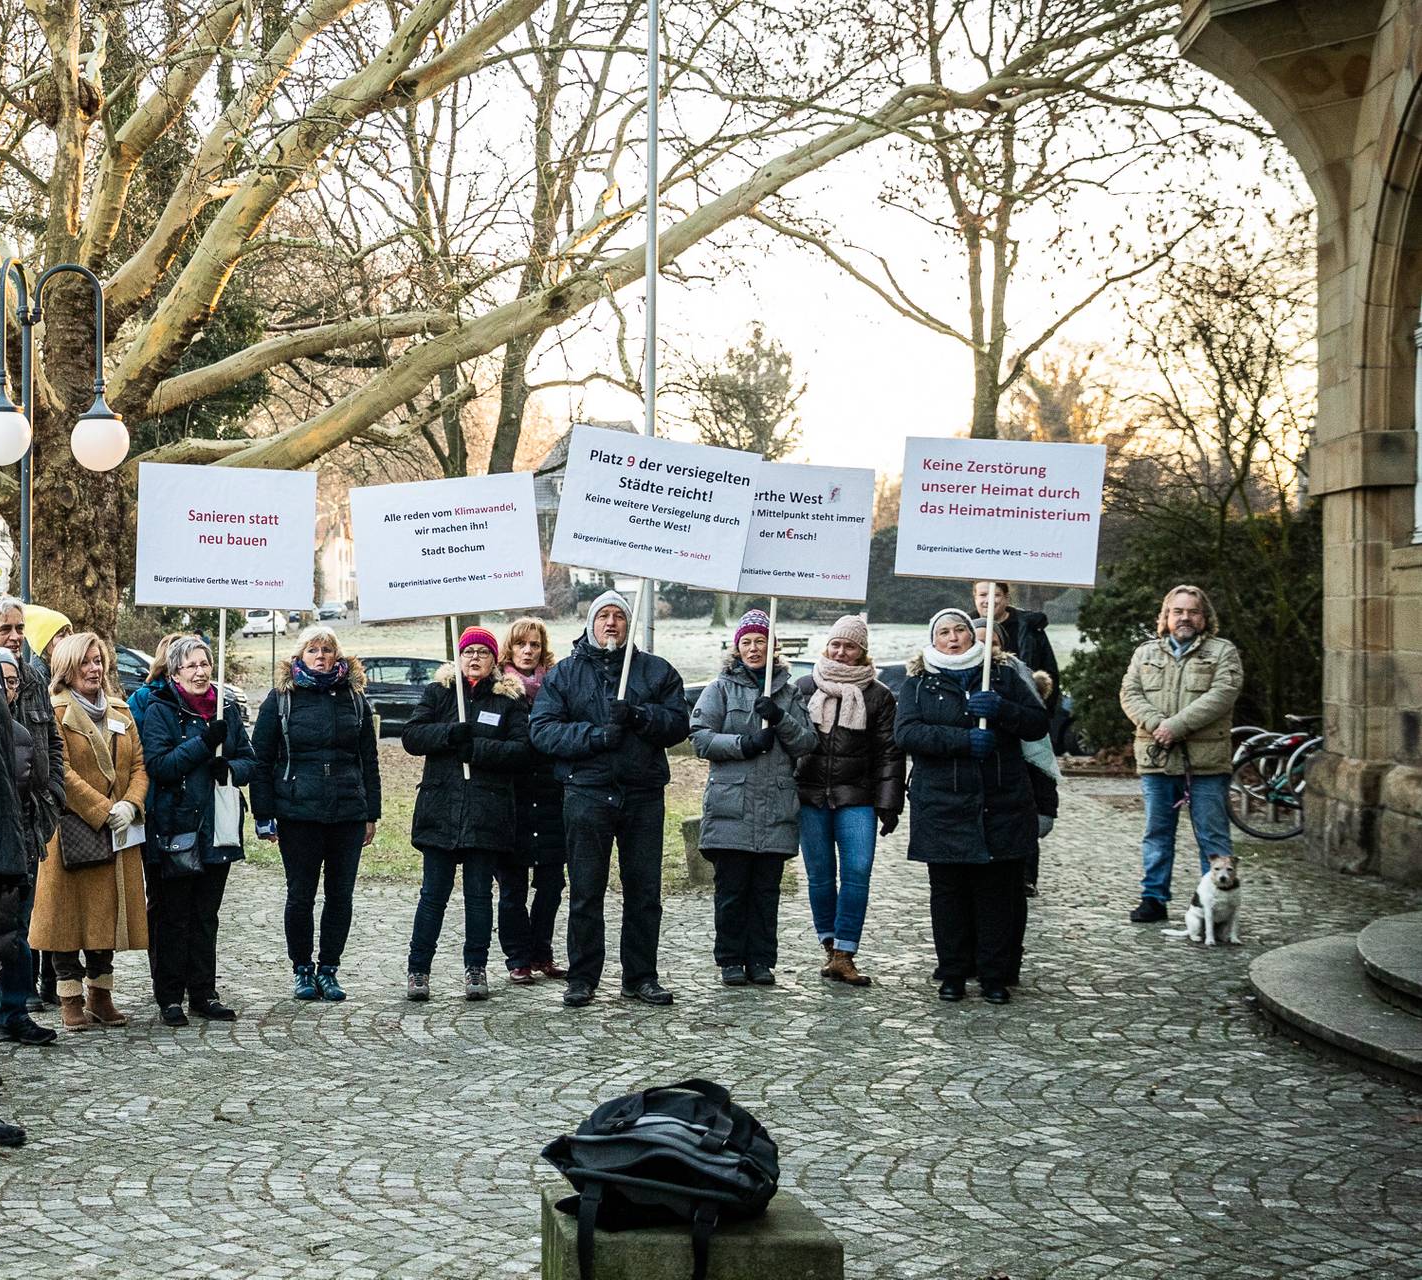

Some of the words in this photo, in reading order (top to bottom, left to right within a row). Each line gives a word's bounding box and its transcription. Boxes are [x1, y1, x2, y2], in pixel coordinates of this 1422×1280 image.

[590, 450, 623, 465] Platz
[627, 456, 635, 467] 9
[639, 458, 662, 471] der
[666, 465, 750, 486] versiegelten
[923, 459, 962, 471] Keine
[967, 461, 1046, 478] Zerstörung
[619, 477, 663, 495] Städte
[668, 487, 713, 502] reicht!
[922, 483, 976, 493] unserer
[982, 484, 1033, 497] Heimat
[1039, 486, 1079, 499] durch
[790, 492, 823, 504] West
[385, 514, 401, 522] Alle
[404, 512, 429, 520] reden
[455, 503, 516, 515] Klimawandel,
[586, 493, 611, 504] Keine
[614, 500, 648, 511] weitere
[652, 504, 711, 523] Versiegelung
[714, 514, 739, 525] durch
[757, 509, 809, 519] Mittelpunkt
[812, 513, 834, 521] steht
[837, 514, 865, 523] immer
[920, 502, 944, 514] das
[949, 504, 1090, 521] Heimatministerium
[189, 510, 244, 523] Sanieren
[249, 514, 278, 525] statt
[629, 515, 661, 527] Gerthe
[664, 521, 690, 532] West!
[415, 527, 429, 535] wir
[432, 524, 467, 533] machen
[470, 521, 487, 530] ihn!
[760, 530, 774, 538] der
[777, 529, 816, 540] M€nsch!
[200, 535, 222, 544] neu
[228, 533, 266, 546] bauen
[573, 533, 627, 547] Bürgerinitiative
[628, 542, 652, 551] Gerthe
[655, 546, 672, 554] West
[422, 547, 445, 556] Stadt
[448, 544, 484, 553] Bochum
[917, 544, 973, 553] Bürgerinitiative
[389, 579, 441, 588] Bürgerinitiative
